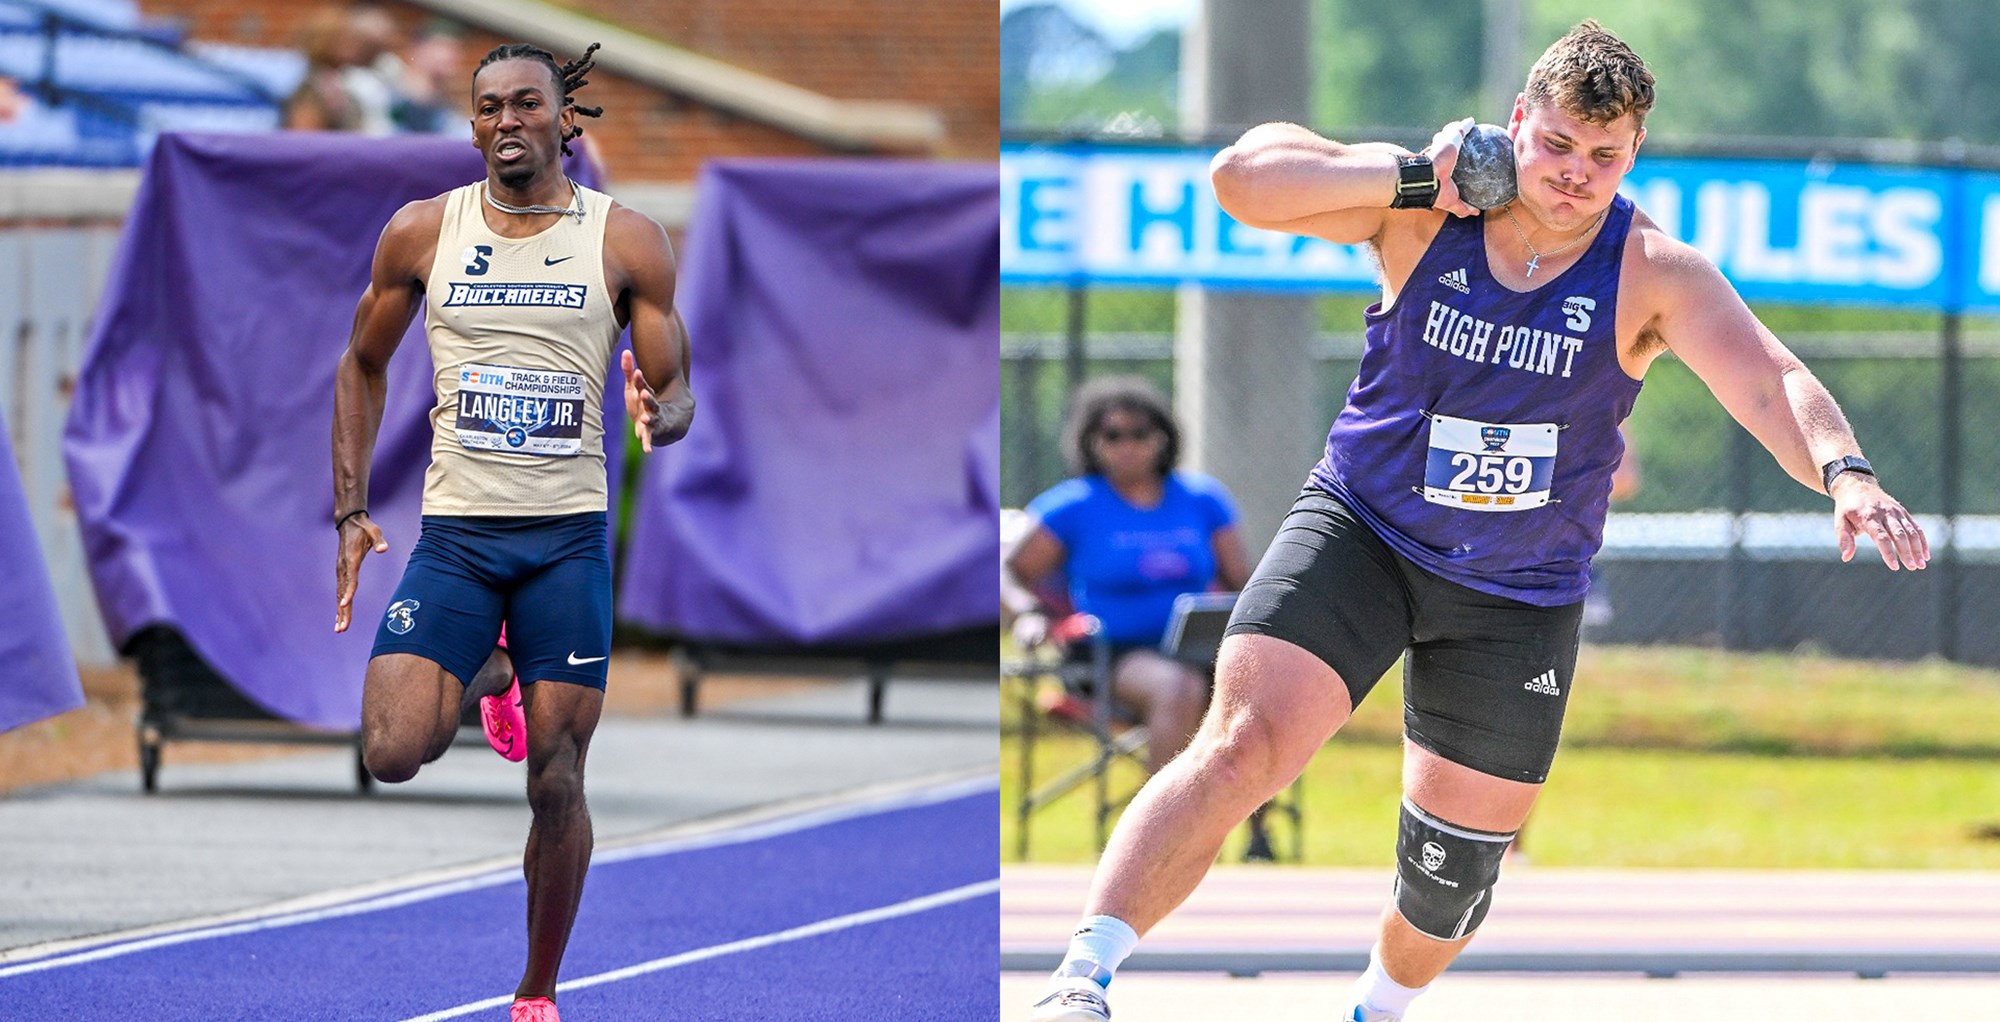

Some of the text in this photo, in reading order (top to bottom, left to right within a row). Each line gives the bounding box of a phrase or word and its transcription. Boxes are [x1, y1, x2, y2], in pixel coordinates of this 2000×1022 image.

[1438, 275, 1471, 295] adidas
[1422, 300, 1584, 378] HIGH POINT
[461, 371, 504, 386] SOUTH
[511, 372, 541, 384] TRACK
[552, 376, 578, 385] FIELD
[504, 381, 582, 395] CHAMPIONSHIPS
[460, 393, 578, 426] LANGLEY JR.
[1448, 453, 1533, 494] 259
[1524, 682, 1560, 696] adidas
